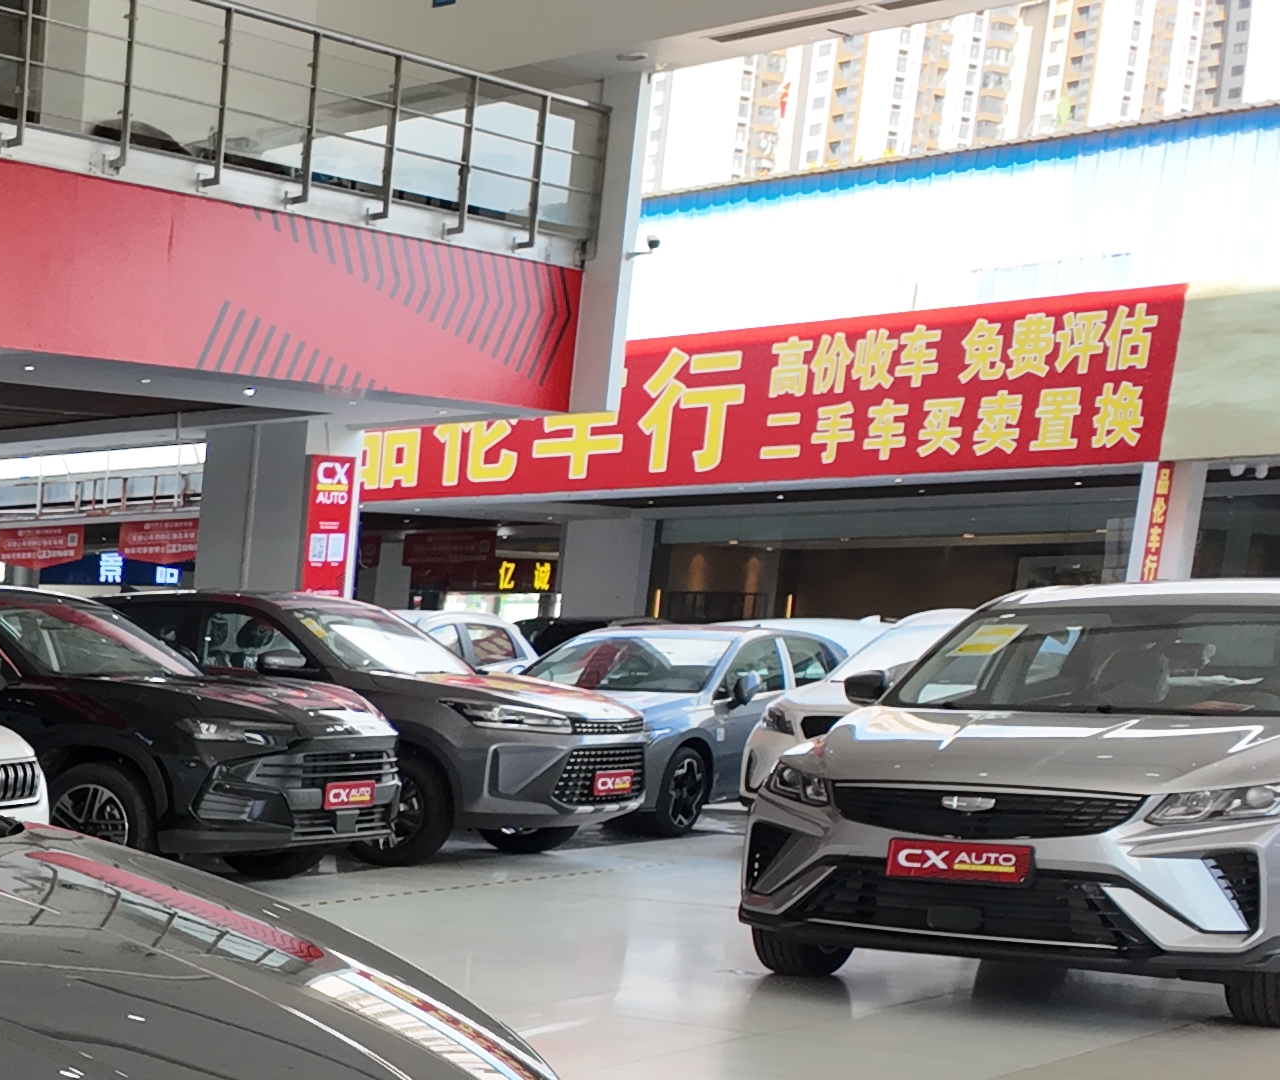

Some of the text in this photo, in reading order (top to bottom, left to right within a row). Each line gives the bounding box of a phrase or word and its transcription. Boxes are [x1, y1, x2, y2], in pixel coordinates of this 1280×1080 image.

[768, 302, 1158, 398] 高价收车 免费评估
[760, 381, 1144, 463] 二手车买卖置换
[317, 462, 351, 485] CX
[316, 491, 348, 504] AUTO
[329, 788, 350, 803] CX
[897, 848, 950, 869] CX
[954, 851, 1016, 866] AUTO
